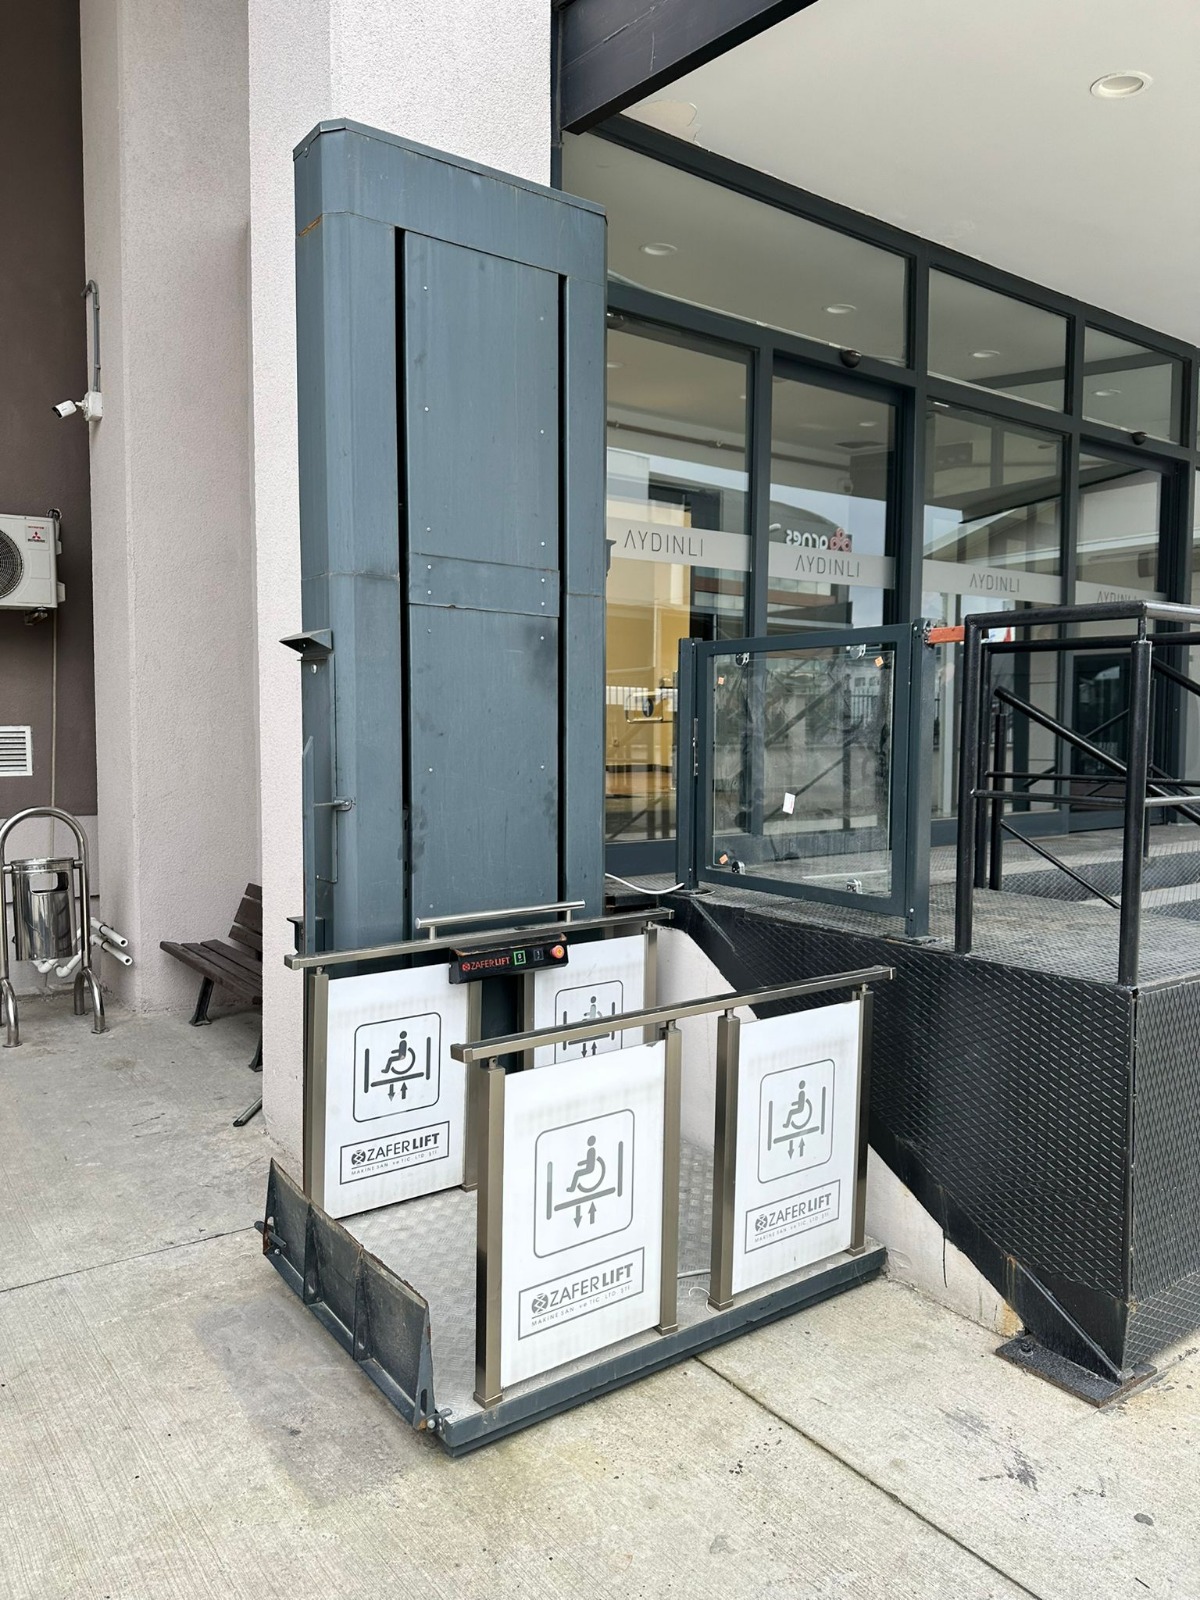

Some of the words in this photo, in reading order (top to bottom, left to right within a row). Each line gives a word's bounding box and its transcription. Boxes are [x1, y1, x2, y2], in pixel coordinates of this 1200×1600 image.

[624, 529, 704, 557] AYDINLI
[795, 554, 860, 578] AYDINLI
[969, 573, 1020, 593] AYDINLI
